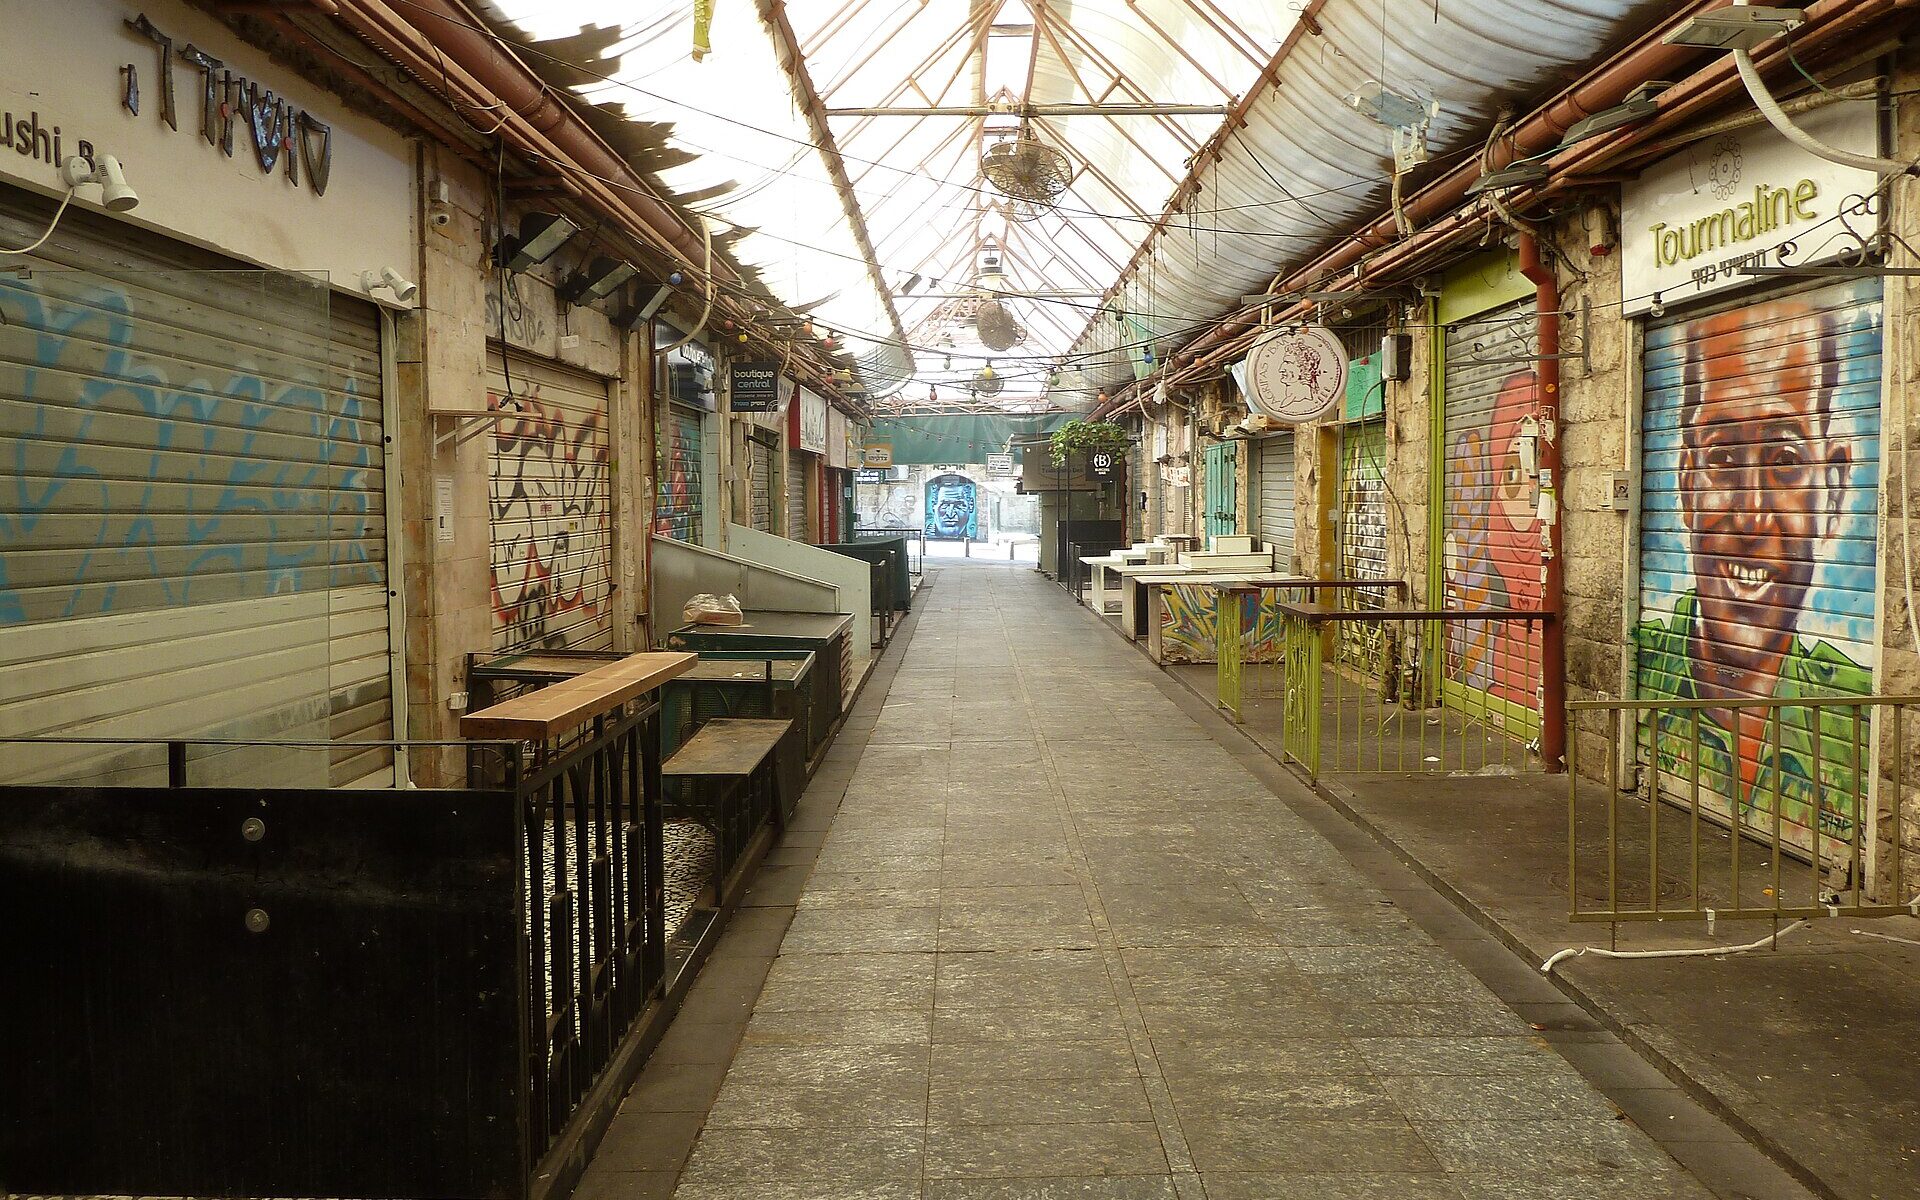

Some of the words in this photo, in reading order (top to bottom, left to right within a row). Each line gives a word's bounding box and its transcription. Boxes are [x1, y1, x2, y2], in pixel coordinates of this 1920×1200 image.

[1649, 179, 1818, 268] Tourmaline
[1691, 264, 1717, 291] כסף
[734, 369, 774, 380] boutique
[737, 379, 771, 388] central
